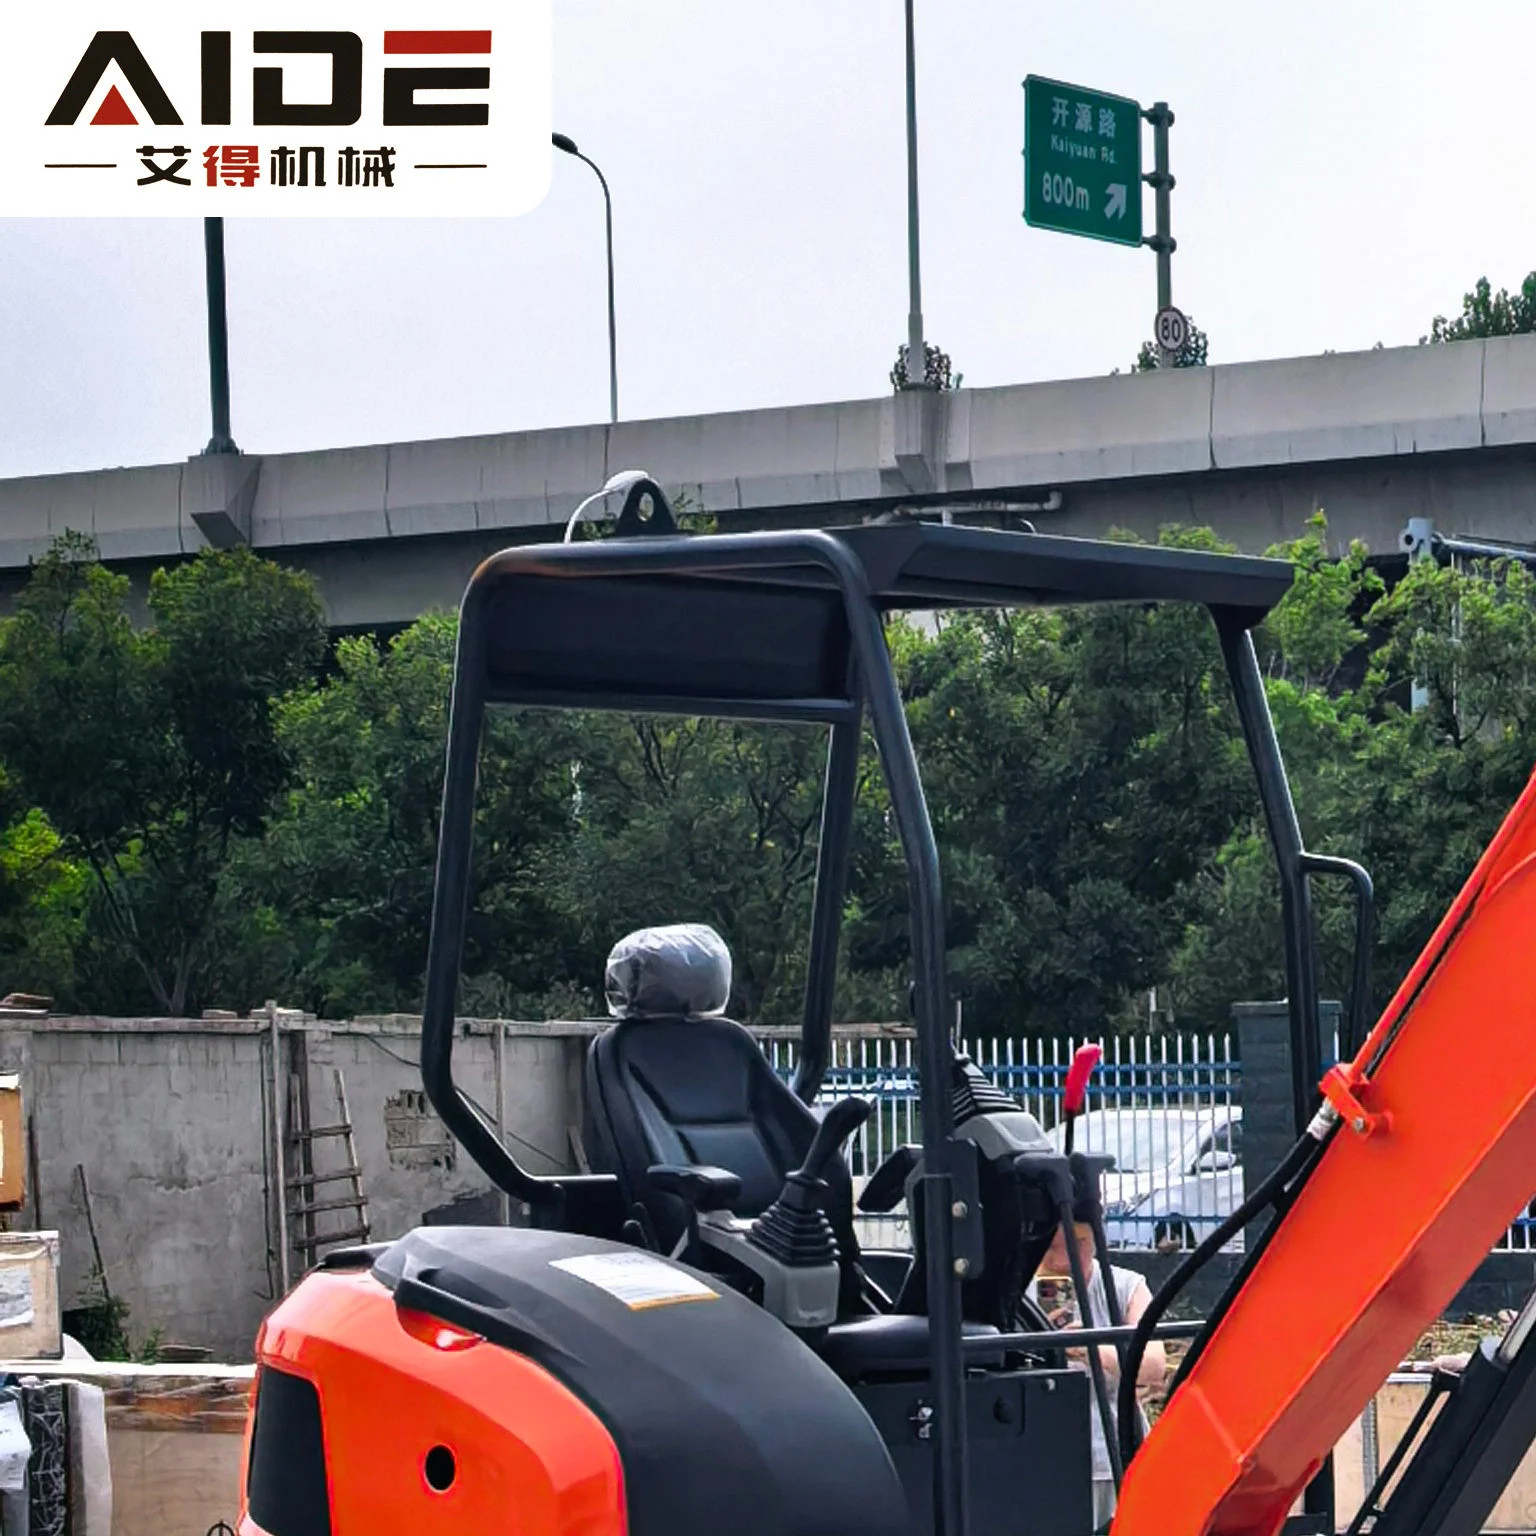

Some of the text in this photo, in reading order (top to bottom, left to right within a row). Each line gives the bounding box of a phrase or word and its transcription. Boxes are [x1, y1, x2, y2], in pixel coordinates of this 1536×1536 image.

[1052, 96, 1116, 138] 开源路
[1050, 133, 1096, 160] Kaiyuan
[1042, 170, 1090, 212] 800m
[1161, 317, 1181, 342] 80
